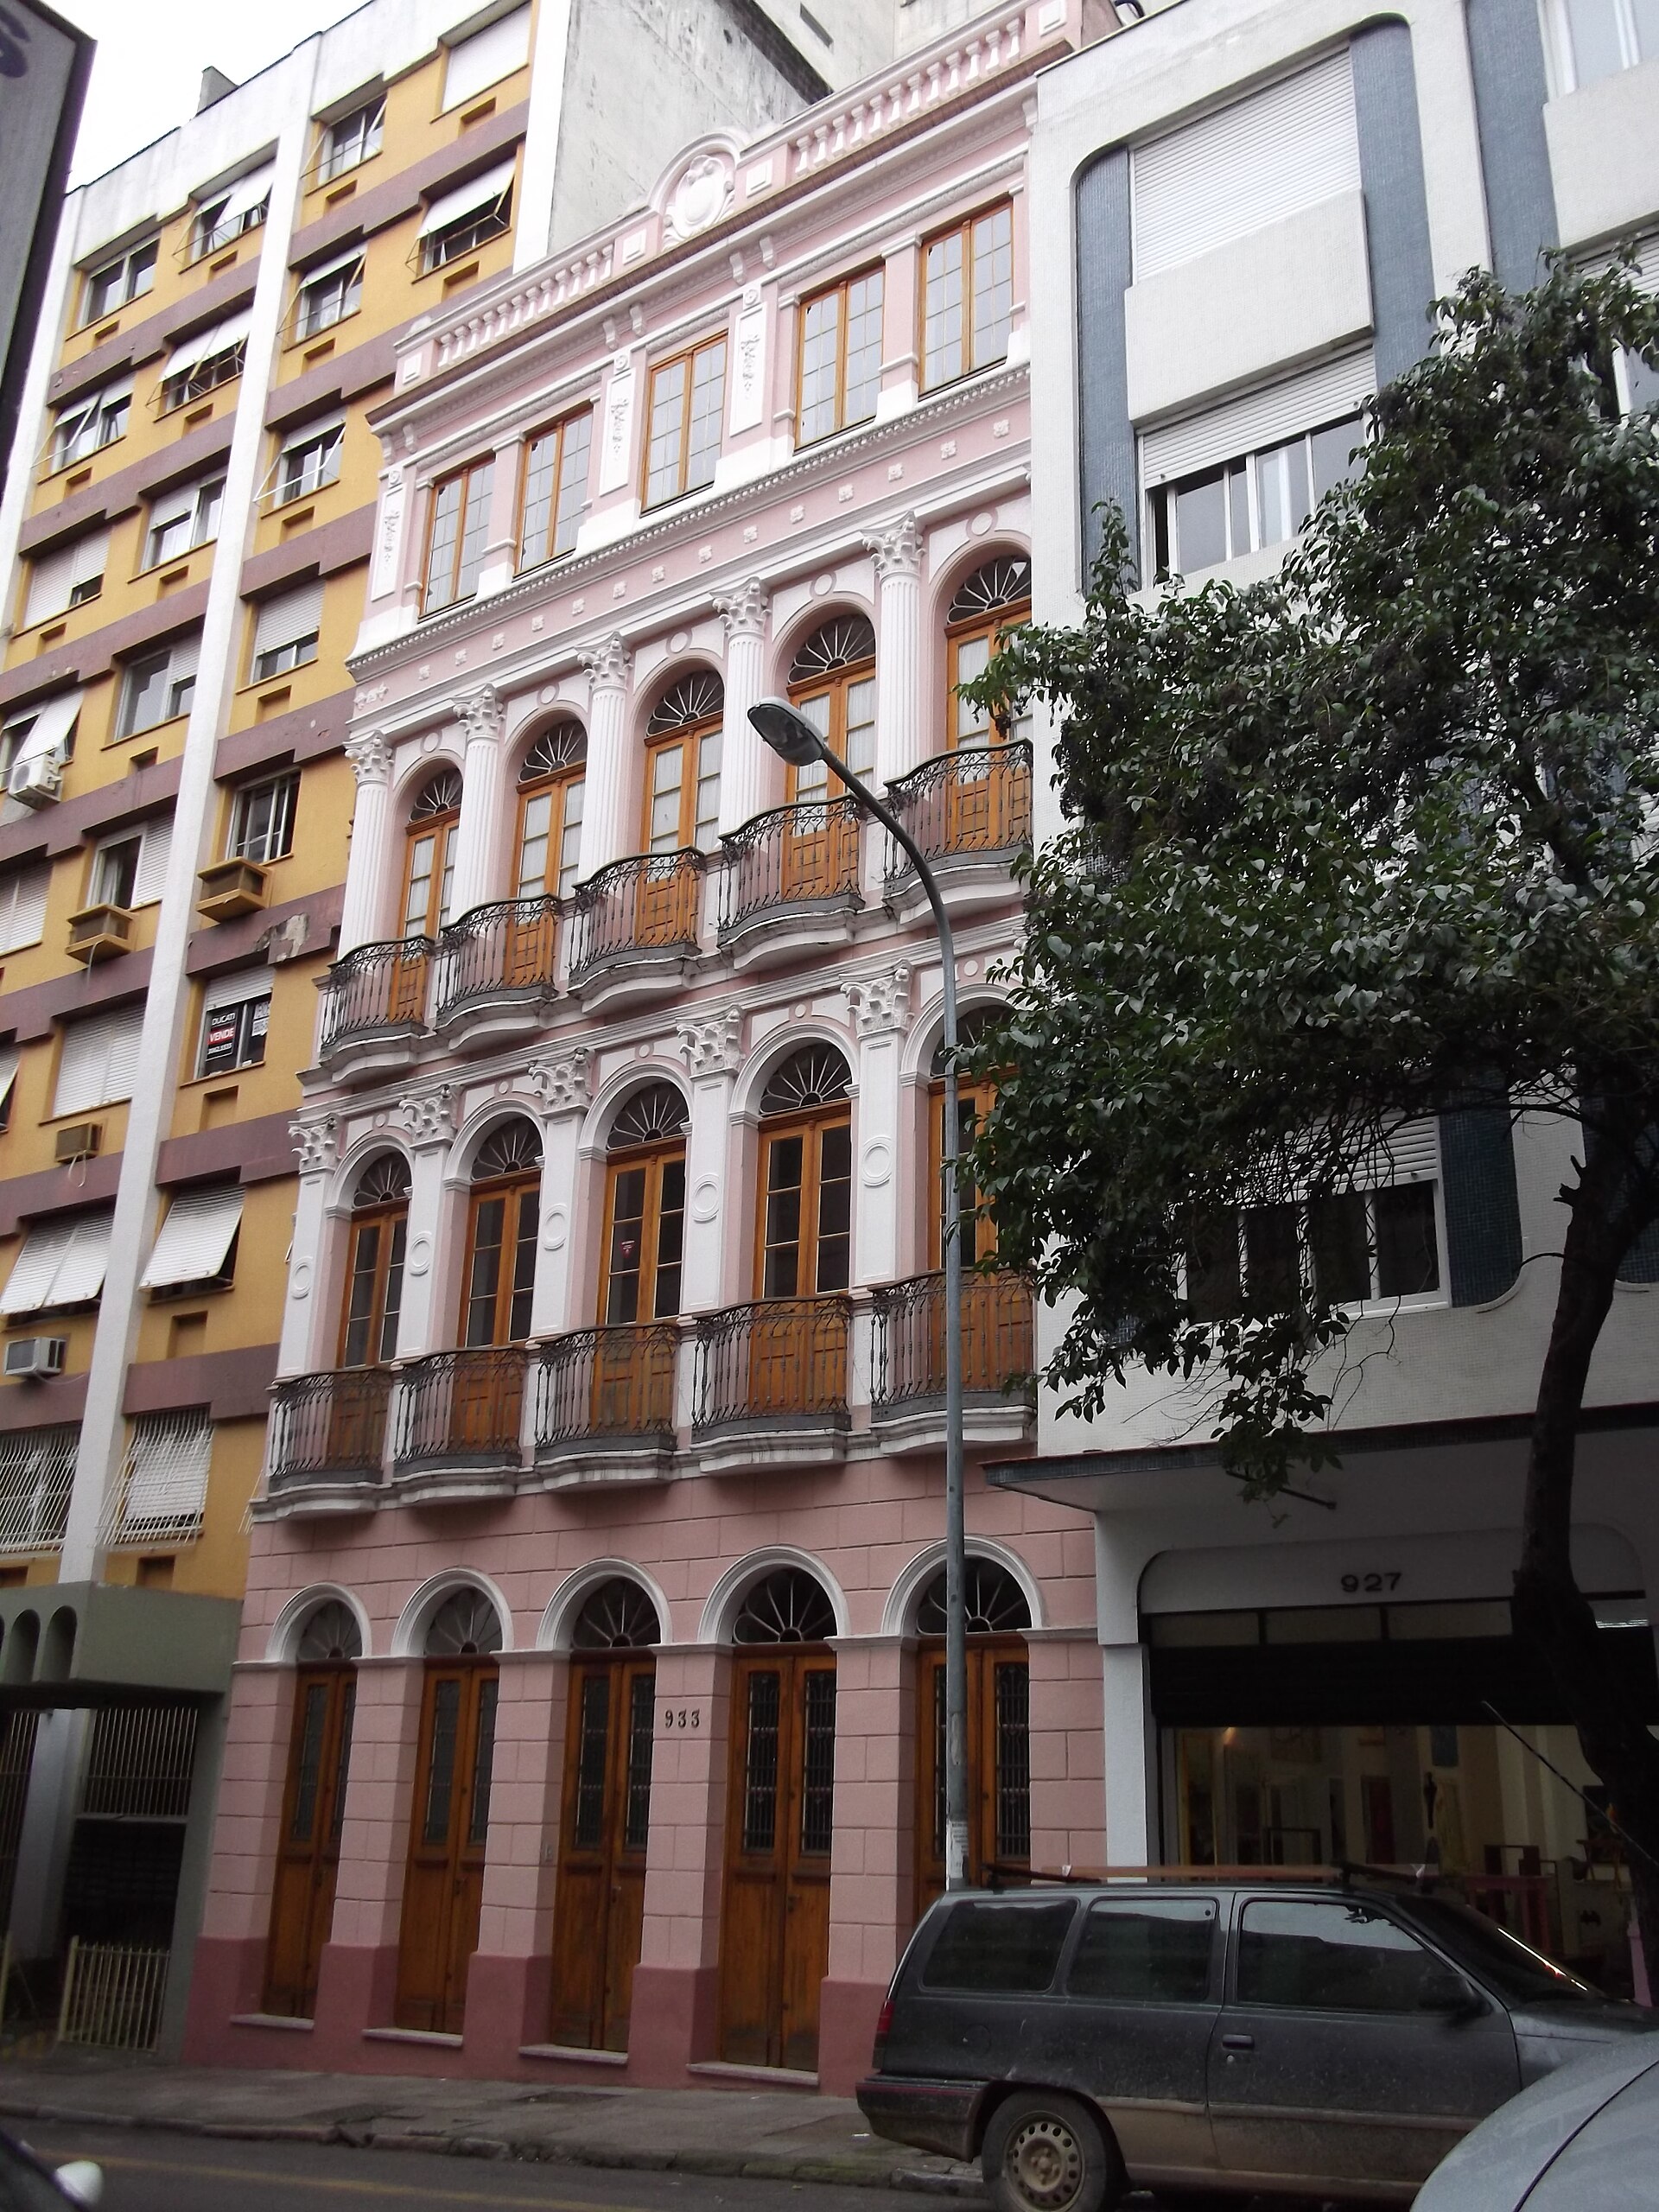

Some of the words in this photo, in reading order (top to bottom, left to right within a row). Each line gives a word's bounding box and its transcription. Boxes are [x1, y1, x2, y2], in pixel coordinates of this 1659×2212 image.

[212, 1013, 235, 1026] DUCATI
[209, 1027, 235, 1042] VENDE
[1340, 1572, 1402, 1592] 927
[665, 1708, 700, 1728] 933
